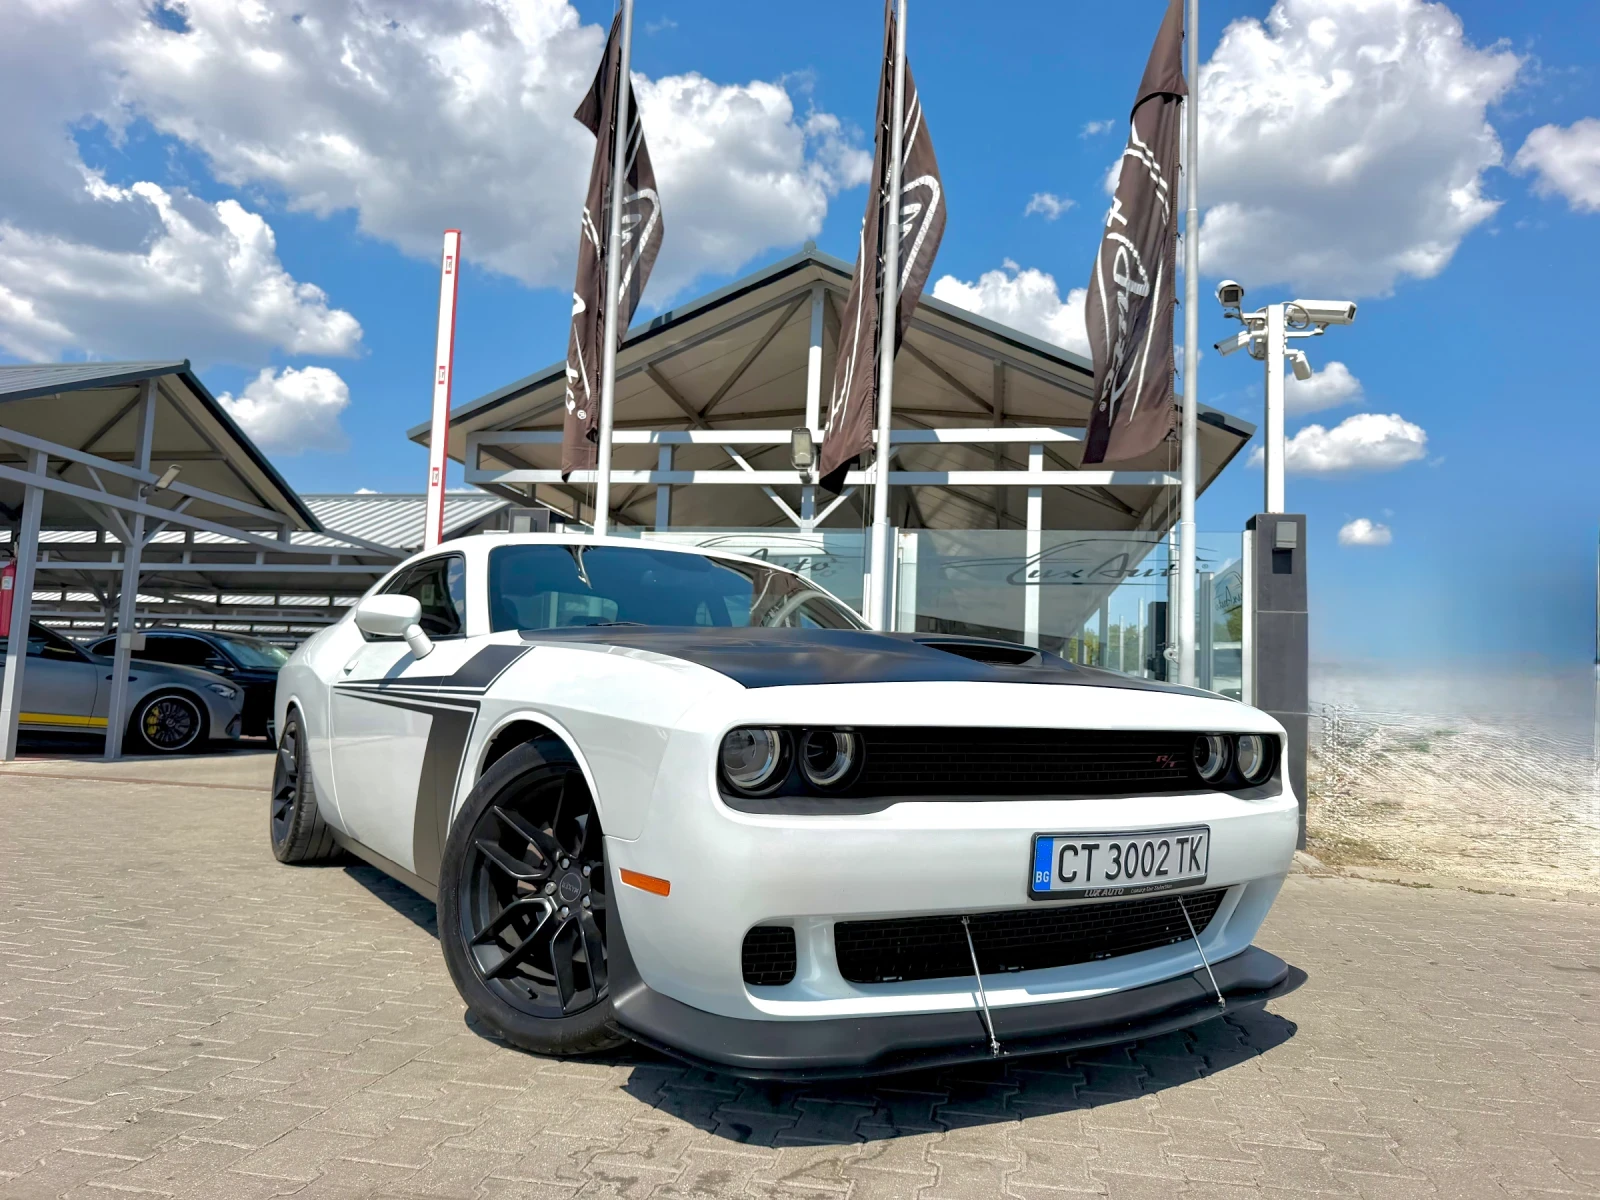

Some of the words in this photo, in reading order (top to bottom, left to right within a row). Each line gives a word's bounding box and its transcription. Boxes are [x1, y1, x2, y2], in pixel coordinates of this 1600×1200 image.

[1058, 843, 1100, 882] CT
[1104, 839, 1170, 880] 3002
[1175, 835, 1203, 874] TK
[1035, 871, 1050, 883] BG
[1084, 889, 1100, 897] LUX
[1101, 888, 1124, 896] AUTO
